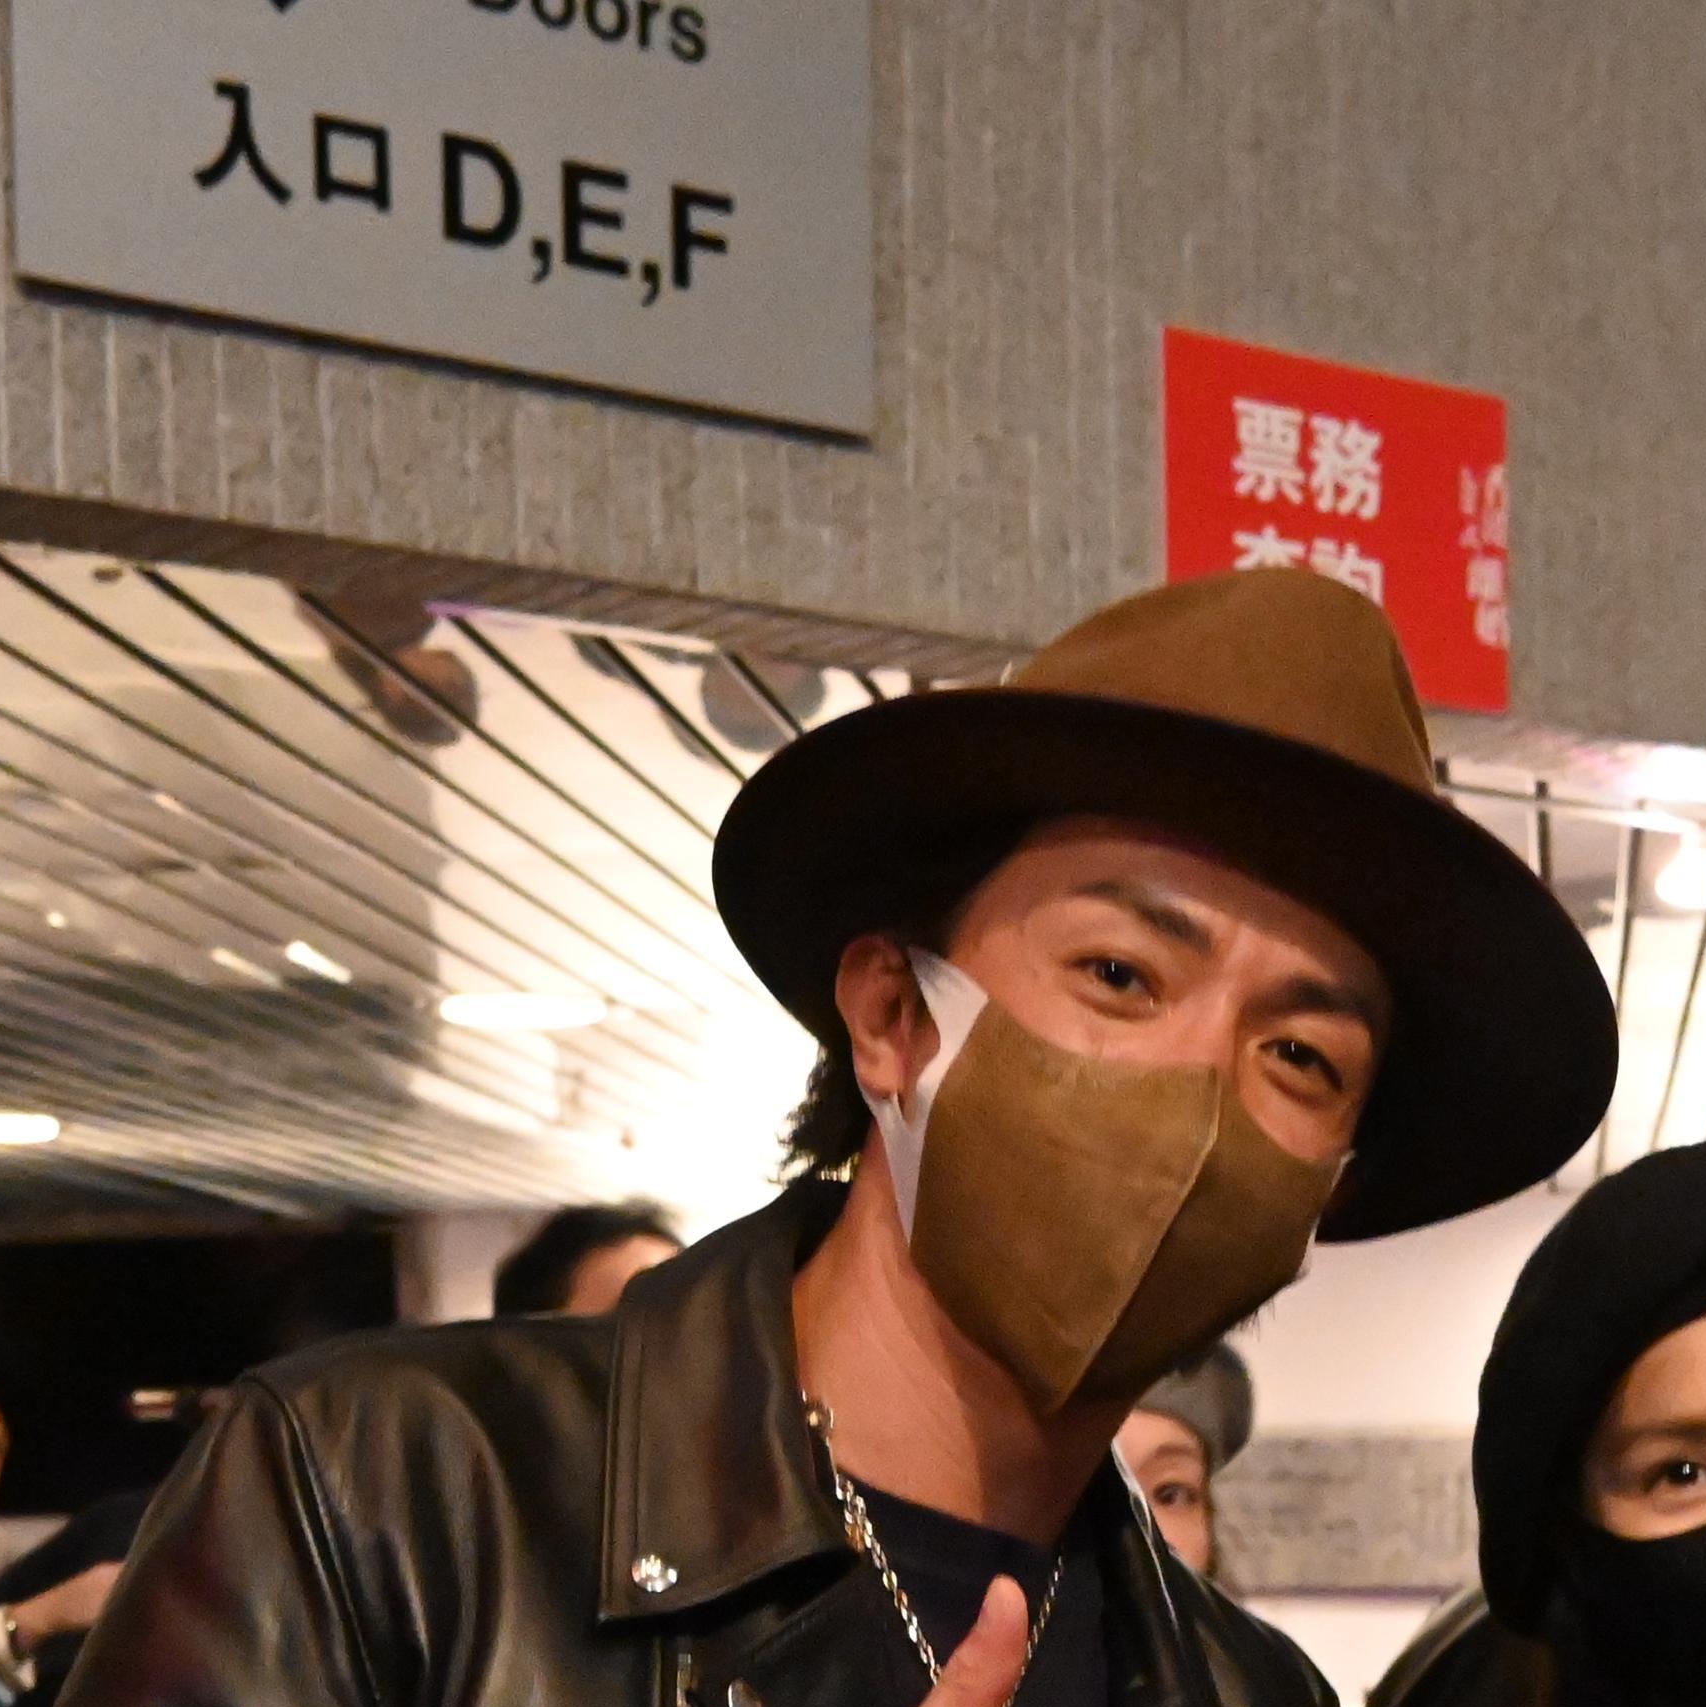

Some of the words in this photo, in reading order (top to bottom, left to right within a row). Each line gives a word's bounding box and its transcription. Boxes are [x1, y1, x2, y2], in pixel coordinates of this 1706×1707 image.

[465, 0, 707, 64] oors
[193, 79, 391, 212] 入口
[441, 132, 734, 307] D,E,F
[1232, 396, 1384, 520] 票務
